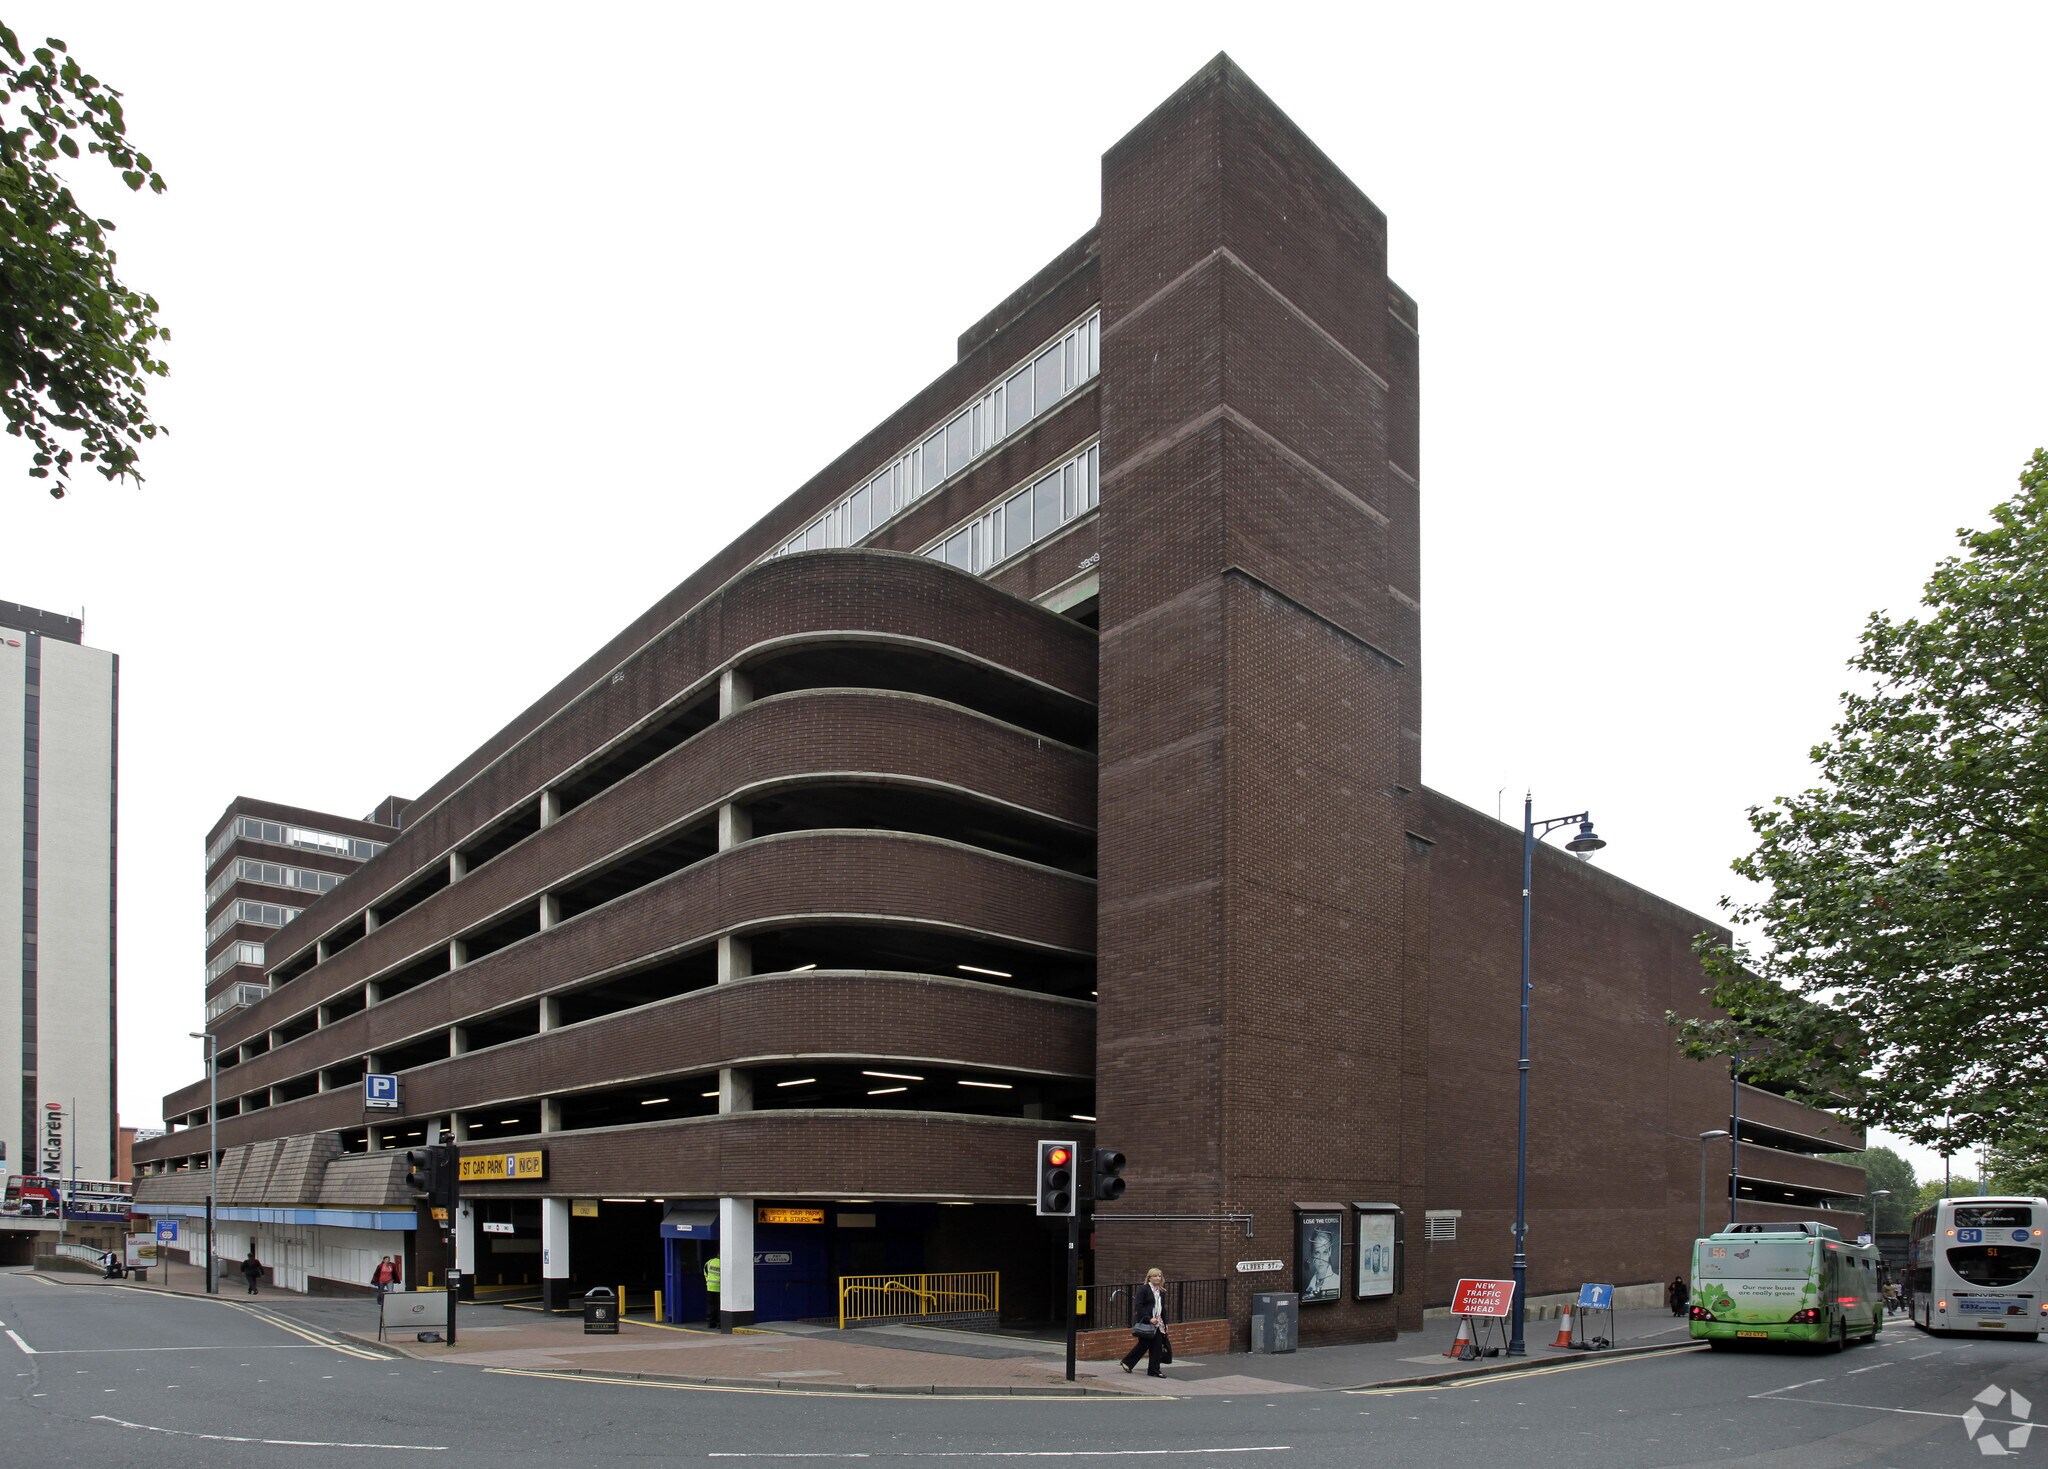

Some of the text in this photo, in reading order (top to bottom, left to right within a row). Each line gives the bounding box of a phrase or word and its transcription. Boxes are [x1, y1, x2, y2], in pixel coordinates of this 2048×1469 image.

[373, 1078, 390, 1096] P
[463, 1162, 470, 1175] ST
[472, 1161, 485, 1174] CAR
[487, 1160, 503, 1174] PARK
[508, 1157, 514, 1174] P
[519, 1157, 539, 1172] NCP
[1961, 1230, 1977, 1241] 51
[1712, 1247, 1726, 1258] 56
[1987, 1247, 1998, 1257] 51
[1241, 1262, 1264, 1271] ALBERT
[1466, 1289, 1501, 1297] TRAFFIC
[1462, 1297, 1501, 1306] SIGNALS
[1464, 1305, 1494, 1313] AHEAD
